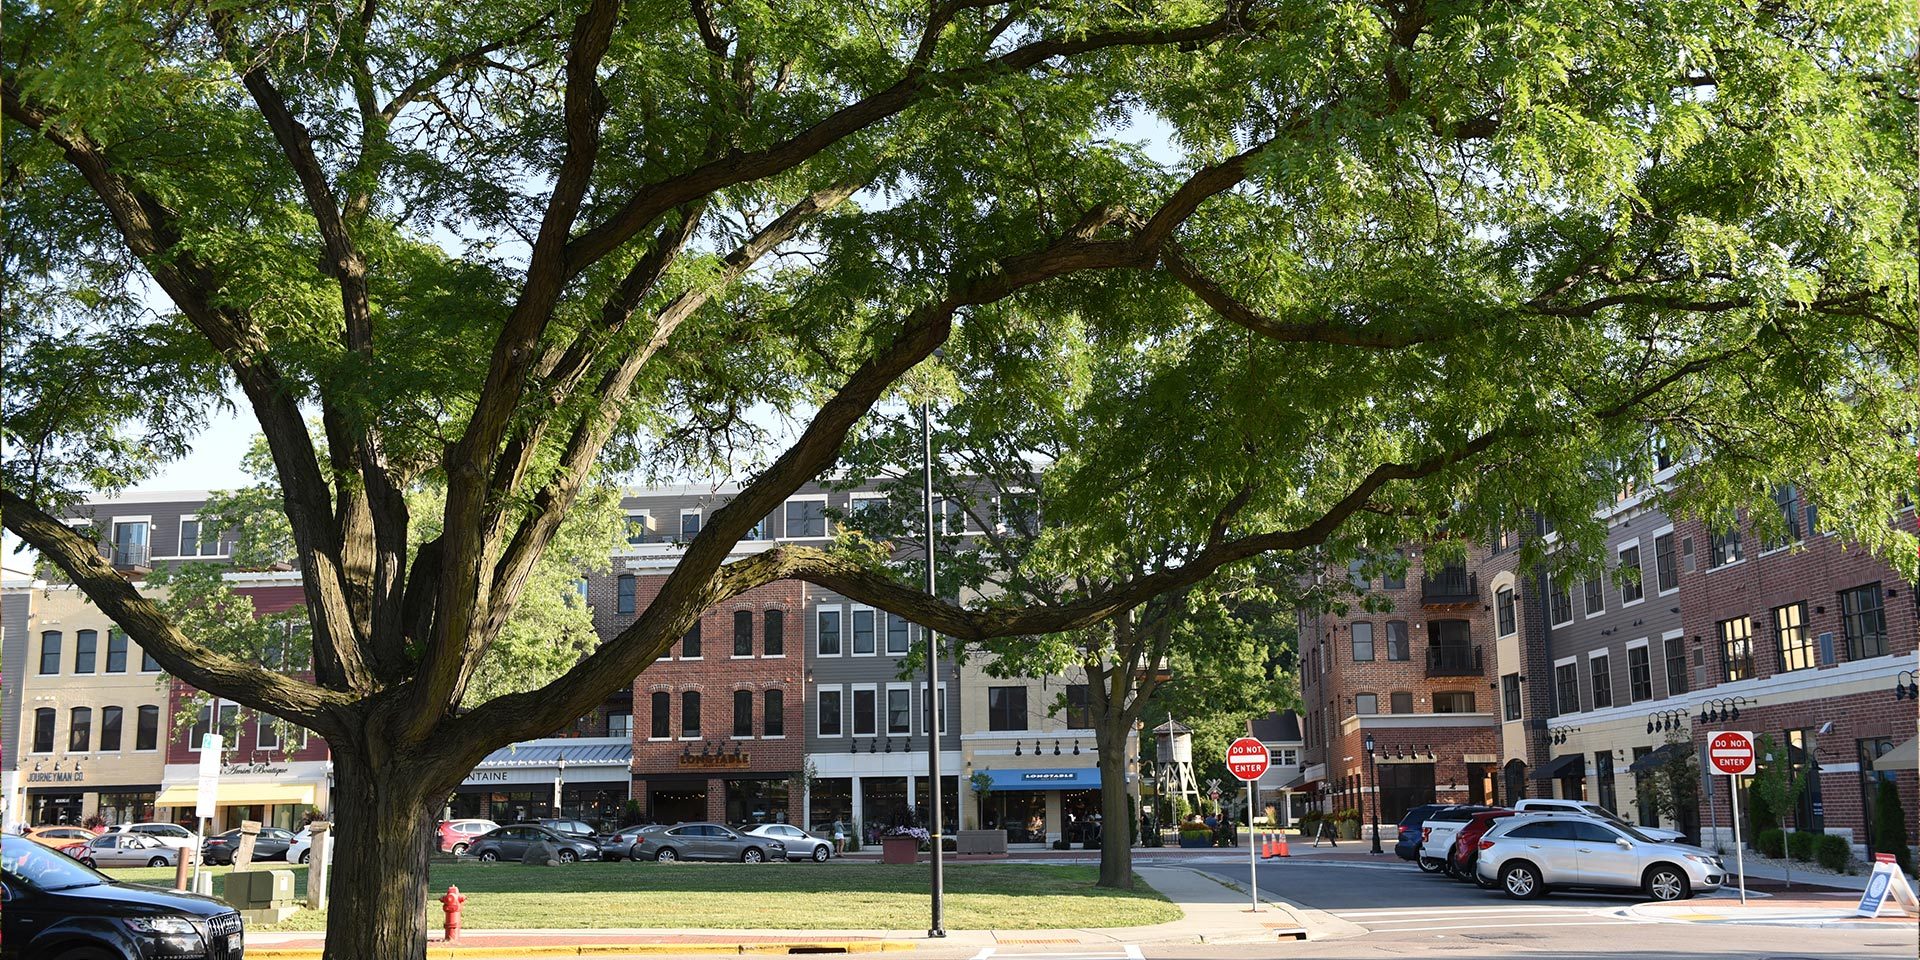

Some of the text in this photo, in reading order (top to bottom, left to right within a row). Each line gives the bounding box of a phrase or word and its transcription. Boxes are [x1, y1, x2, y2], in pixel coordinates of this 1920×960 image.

[1720, 758, 1745, 766] ENTER
[252, 763, 288, 777] Boutique
[1235, 764, 1262, 772] ENTER
[27, 772, 73, 782] JOURNEYMAN
[467, 771, 508, 781] NTAINE
